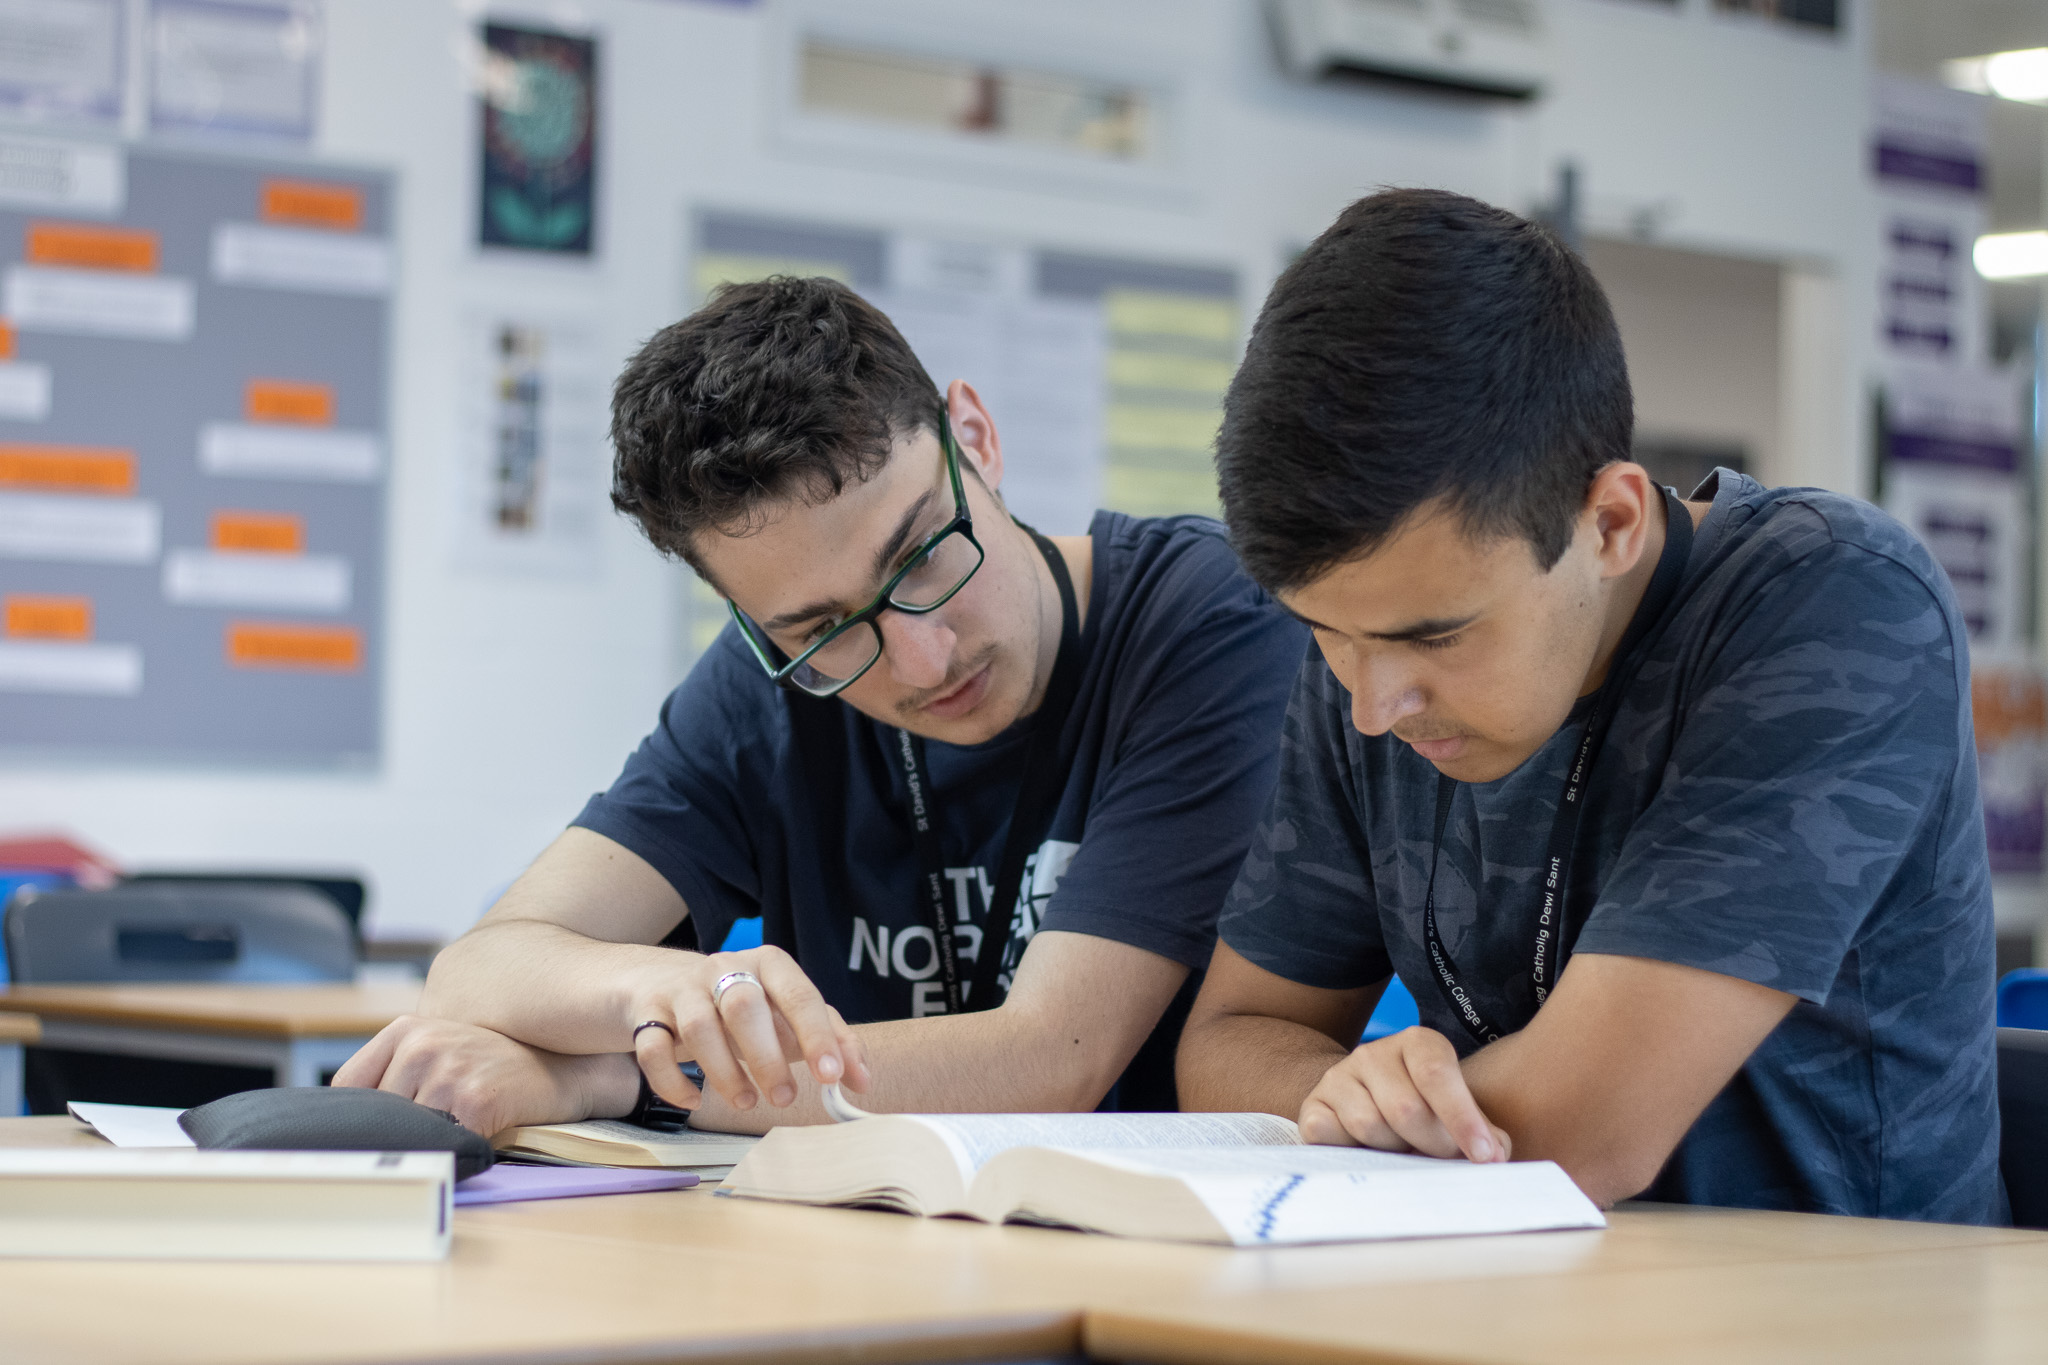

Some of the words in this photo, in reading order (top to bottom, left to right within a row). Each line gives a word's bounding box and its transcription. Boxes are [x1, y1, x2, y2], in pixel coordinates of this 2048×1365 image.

[1566, 787, 1577, 802] St
[1572, 736, 1591, 783] David's
[908, 772, 925, 815] David's
[917, 817, 929, 831] St
[929, 872, 942, 901] Sant
[1547, 856, 1561, 888] Sant
[935, 903, 947, 931] Dewi
[1540, 892, 1555, 925] Dewi
[942, 934, 955, 982] Catholig
[1533, 929, 1550, 983] Catholig
[1430, 941, 1455, 986] Catholic
[1451, 986, 1482, 1026] College
